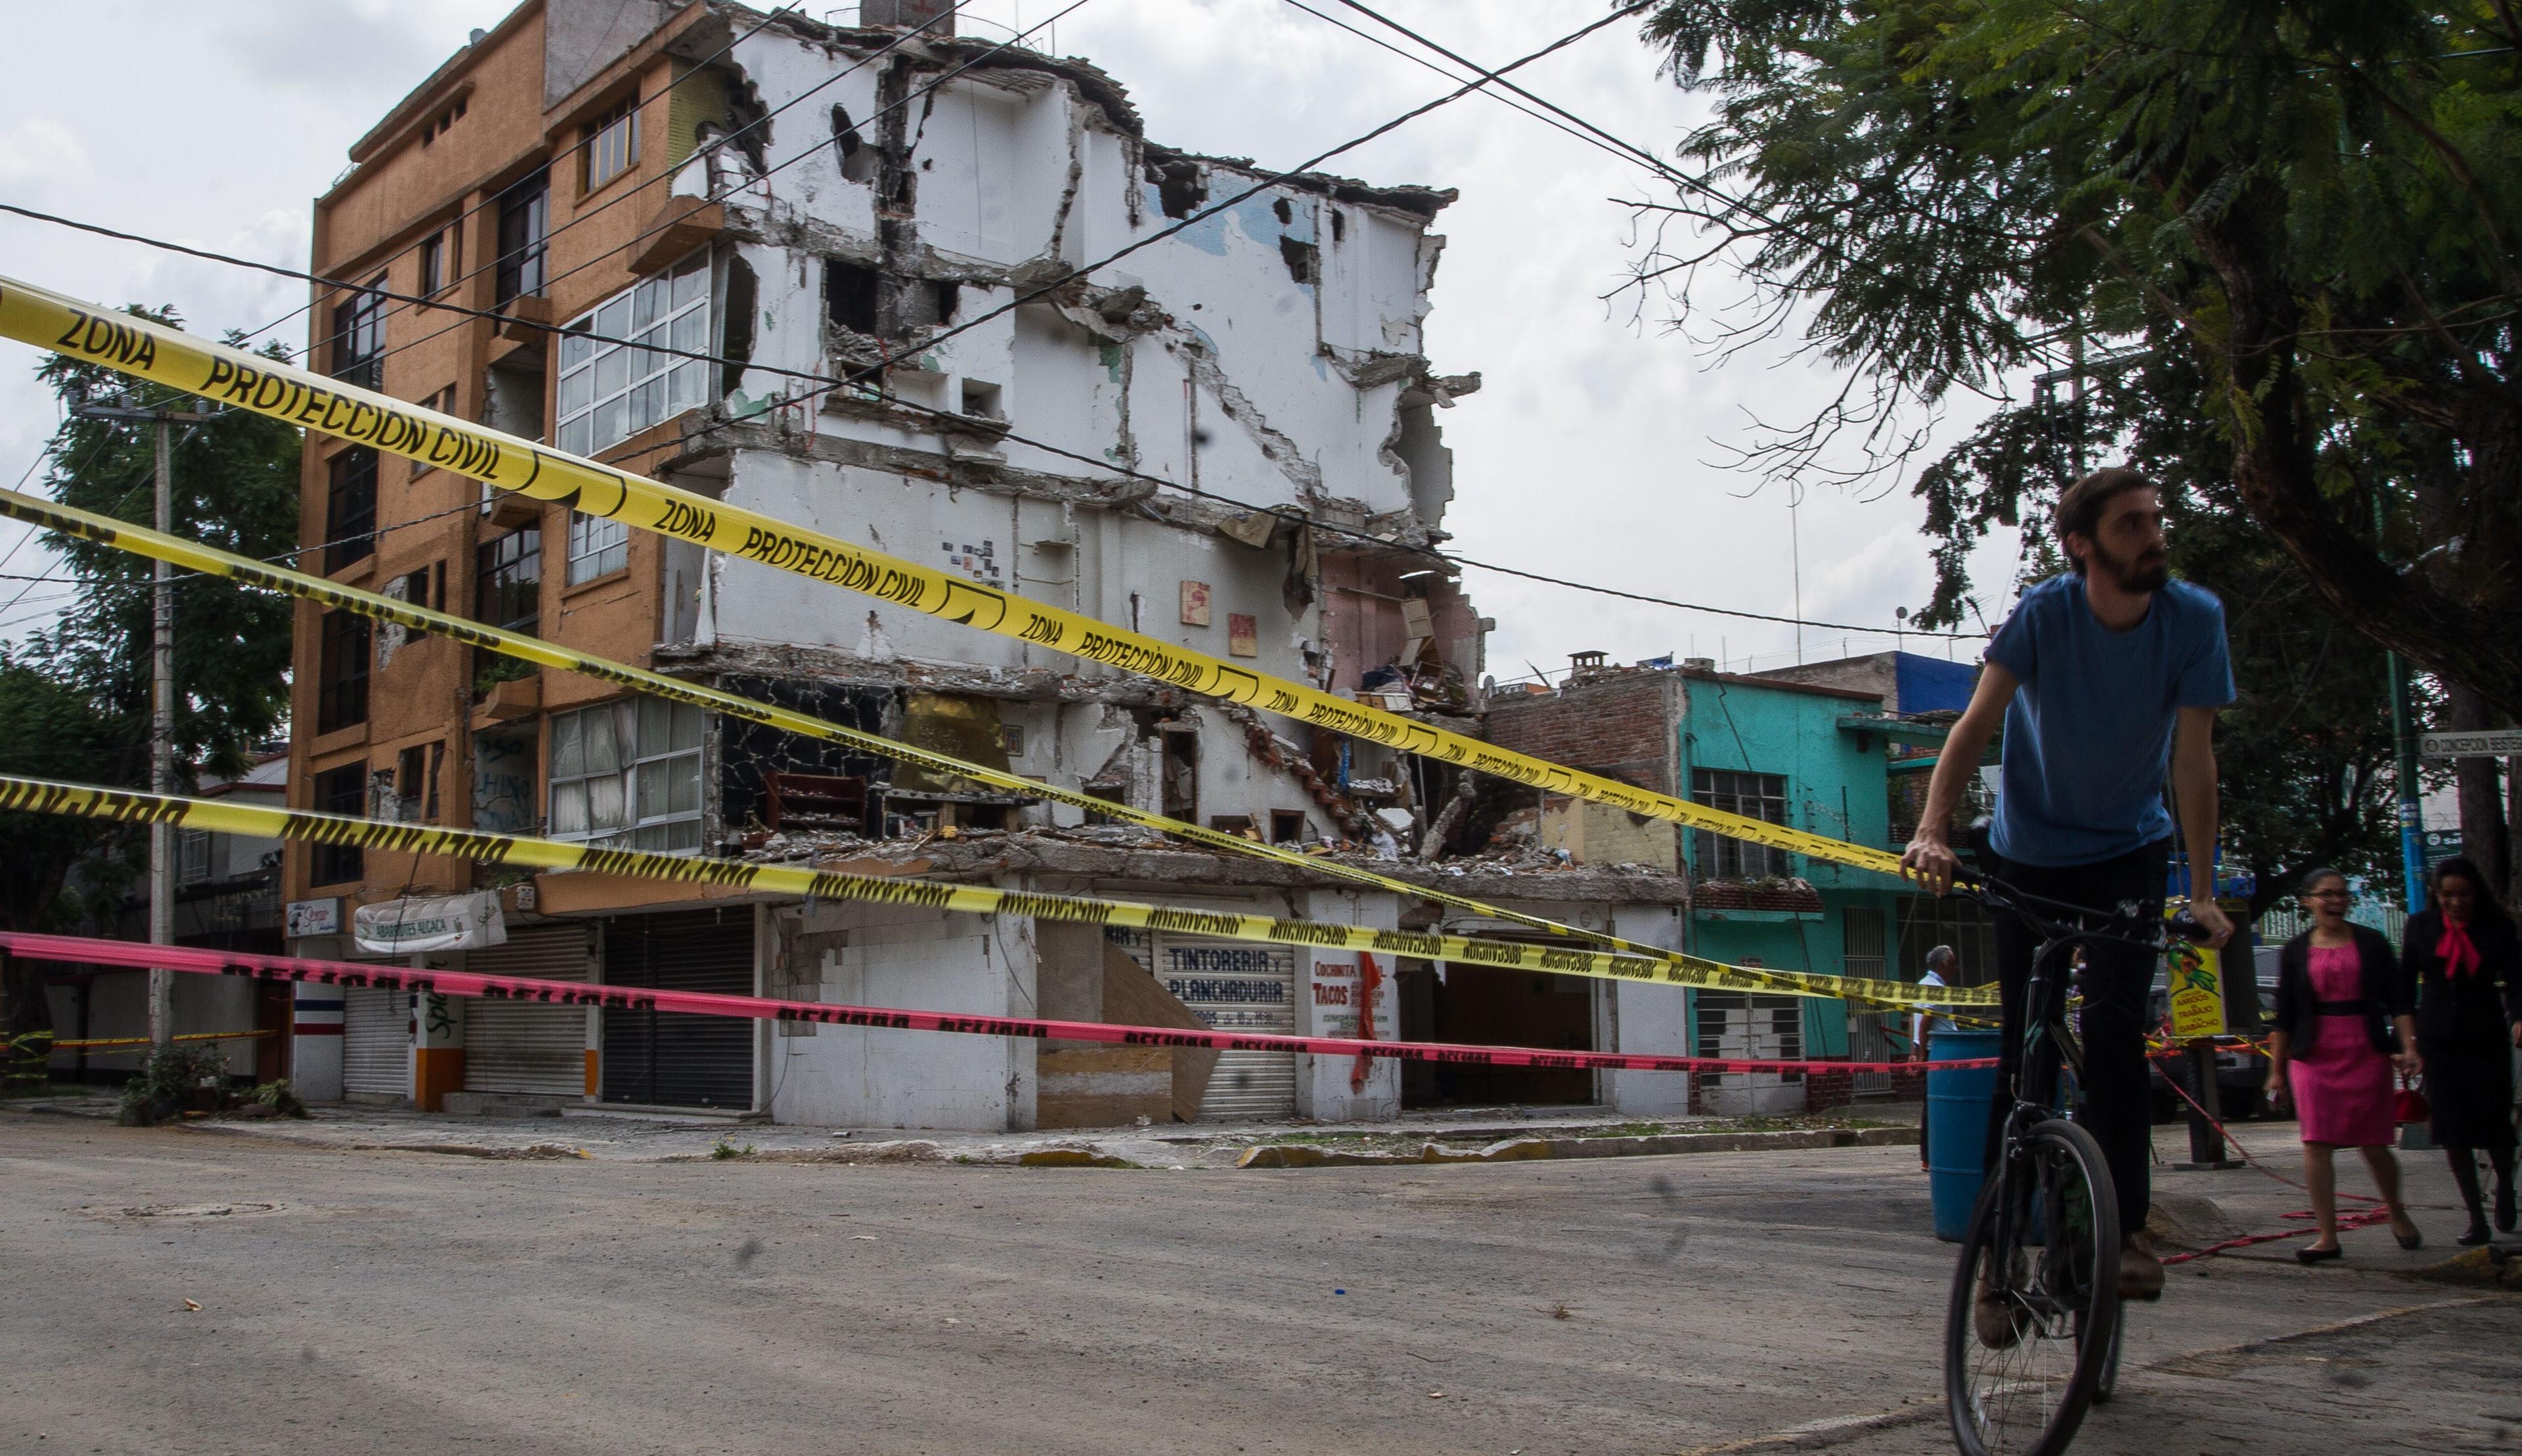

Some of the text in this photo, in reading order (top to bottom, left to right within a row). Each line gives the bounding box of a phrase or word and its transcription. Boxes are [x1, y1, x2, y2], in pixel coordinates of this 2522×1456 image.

[56, 309, 156, 371] ZONA
[428, 428, 500, 479] CIVIL
[653, 498, 717, 542] ZONA
[875, 569, 926, 607] CIVIL
[1018, 613, 1064, 645] ZONA
[1168, 659, 1204, 687] CIVIL
[1265, 690, 1298, 714] ZONA
[1370, 722, 1398, 743] CIVIL
[1168, 948, 1270, 972] TINTORERIA
[1169, 979, 1283, 1002] PLANCHADURIA
[1312, 982, 1348, 1006] TACOS
